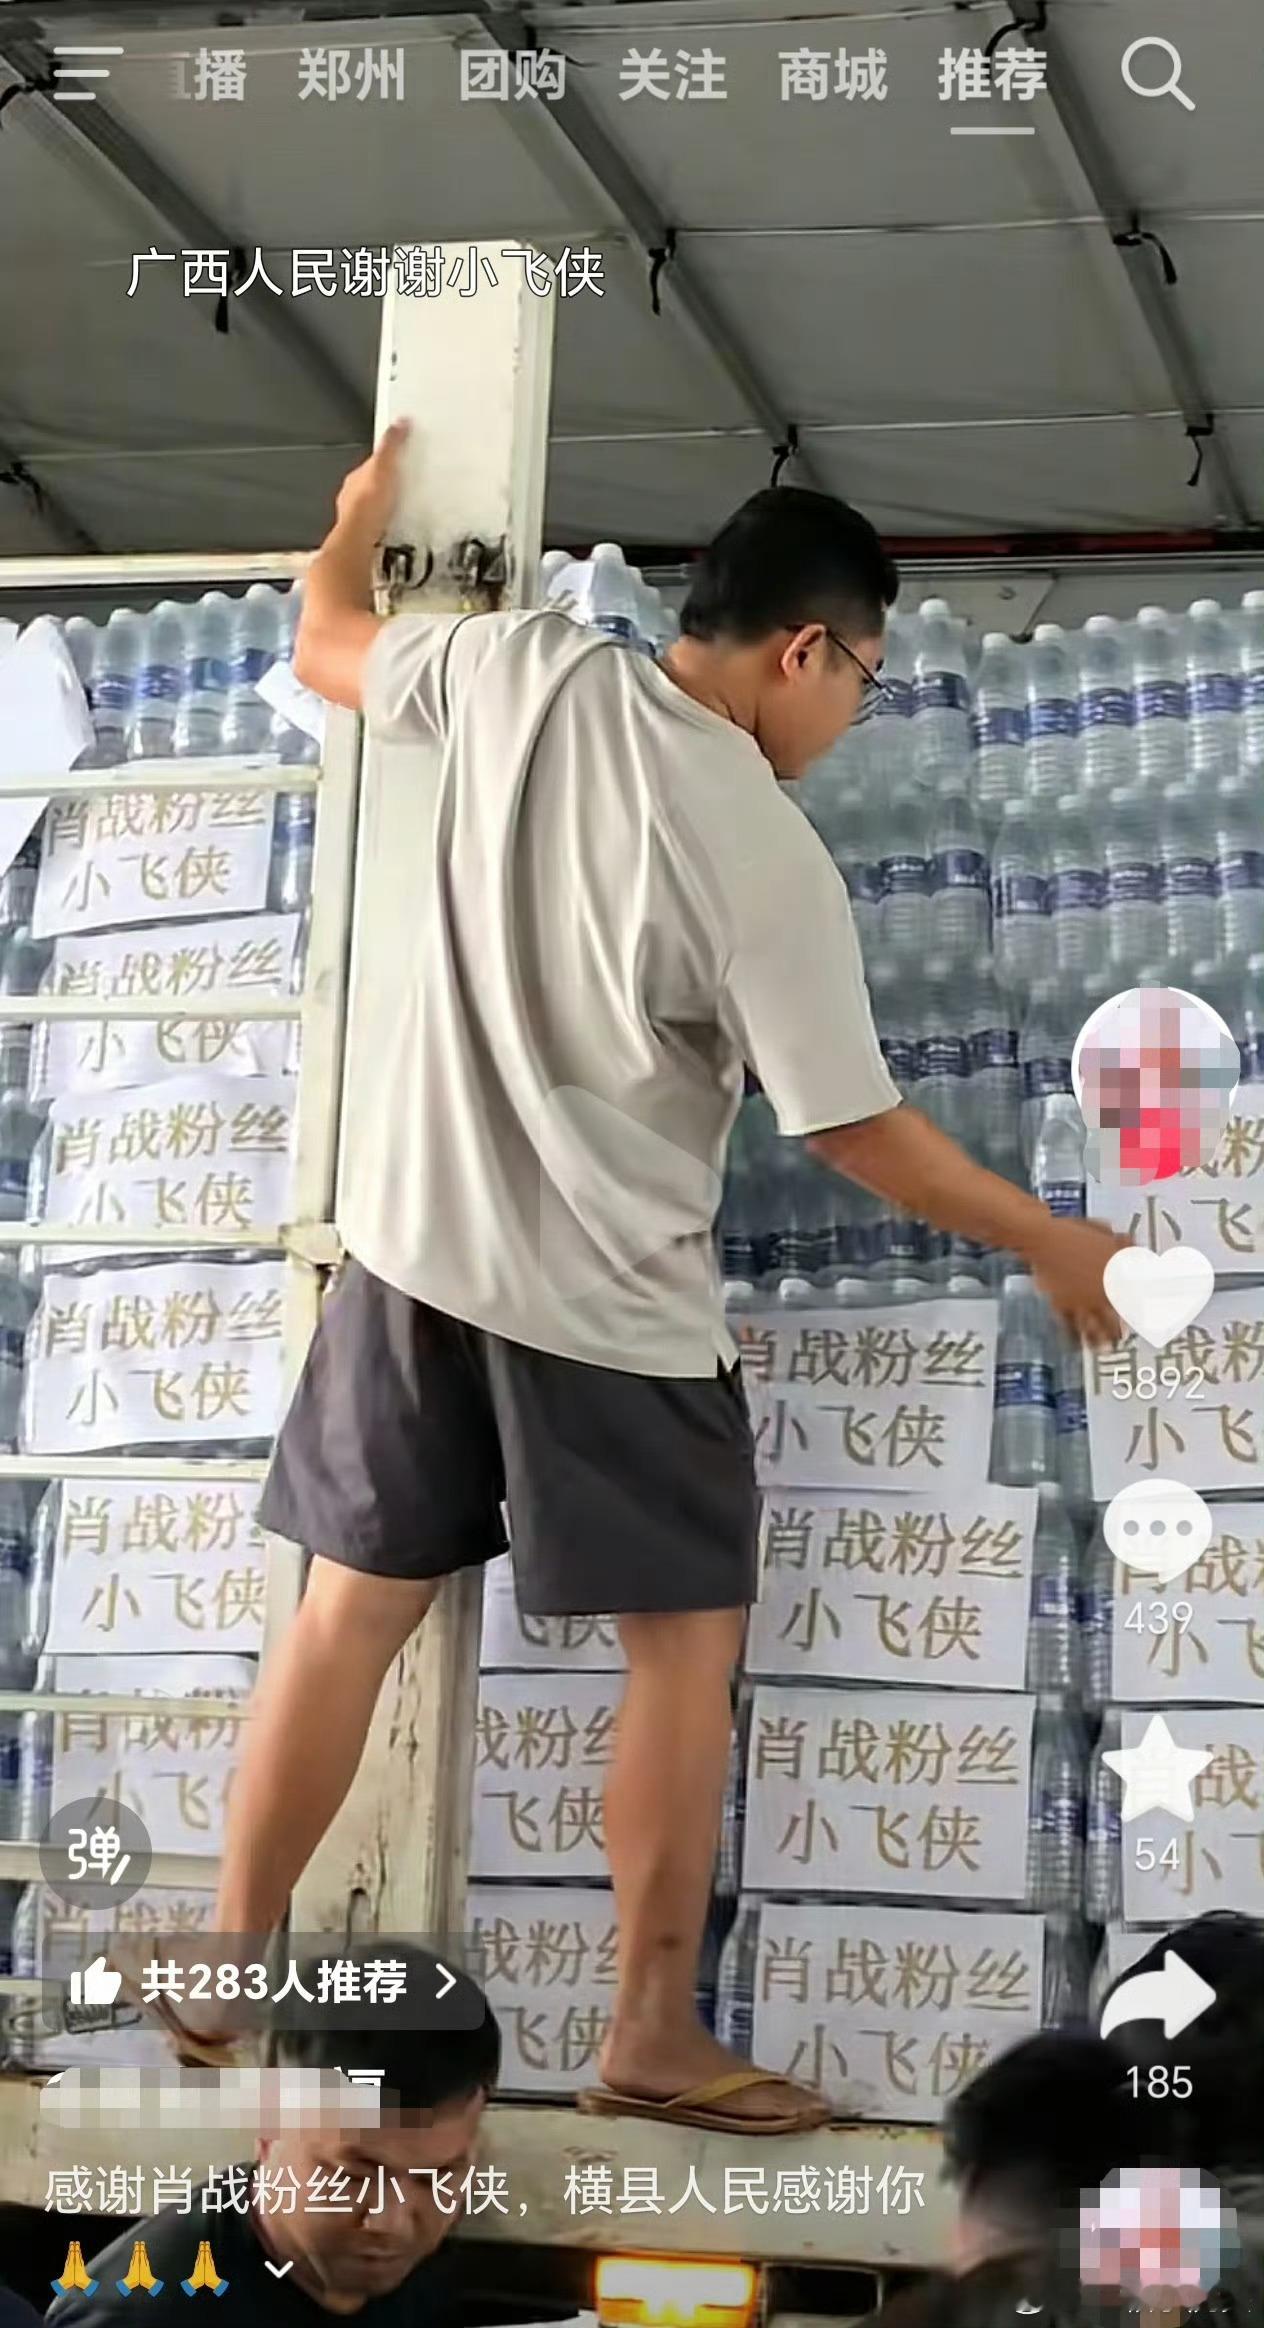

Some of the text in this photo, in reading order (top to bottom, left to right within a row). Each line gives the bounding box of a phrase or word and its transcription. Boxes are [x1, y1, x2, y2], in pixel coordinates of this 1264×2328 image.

[49, 792, 266, 856] 肖战粉丝
[61, 844, 231, 911] 小飞侠
[56, 1101, 288, 1175] 肖战粉丝
[77, 1171, 253, 1230] 小飞侠
[46, 1288, 282, 1358] 肖战粉丝
[740, 1326, 985, 1387] 肖战粉丝
[66, 1360, 249, 1427] 小飞侠
[755, 1400, 945, 1467] 小飞侠
[1124, 1404, 1258, 1471] 小飞
[63, 1492, 265, 1559] 肖战粉
[764, 1507, 1025, 1580] 肖战粉丝
[82, 1566, 265, 1632] 小飞侠
[778, 1586, 983, 1661] 小飞侠
[754, 1716, 1019, 1786] 肖战粉丝
[87, 1767, 238, 1830] 小飞
[482, 1785, 605, 1853] 飞侠
[777, 1799, 982, 1872] 小飞侠
[762, 1936, 1031, 2011] 肖战粉丝
